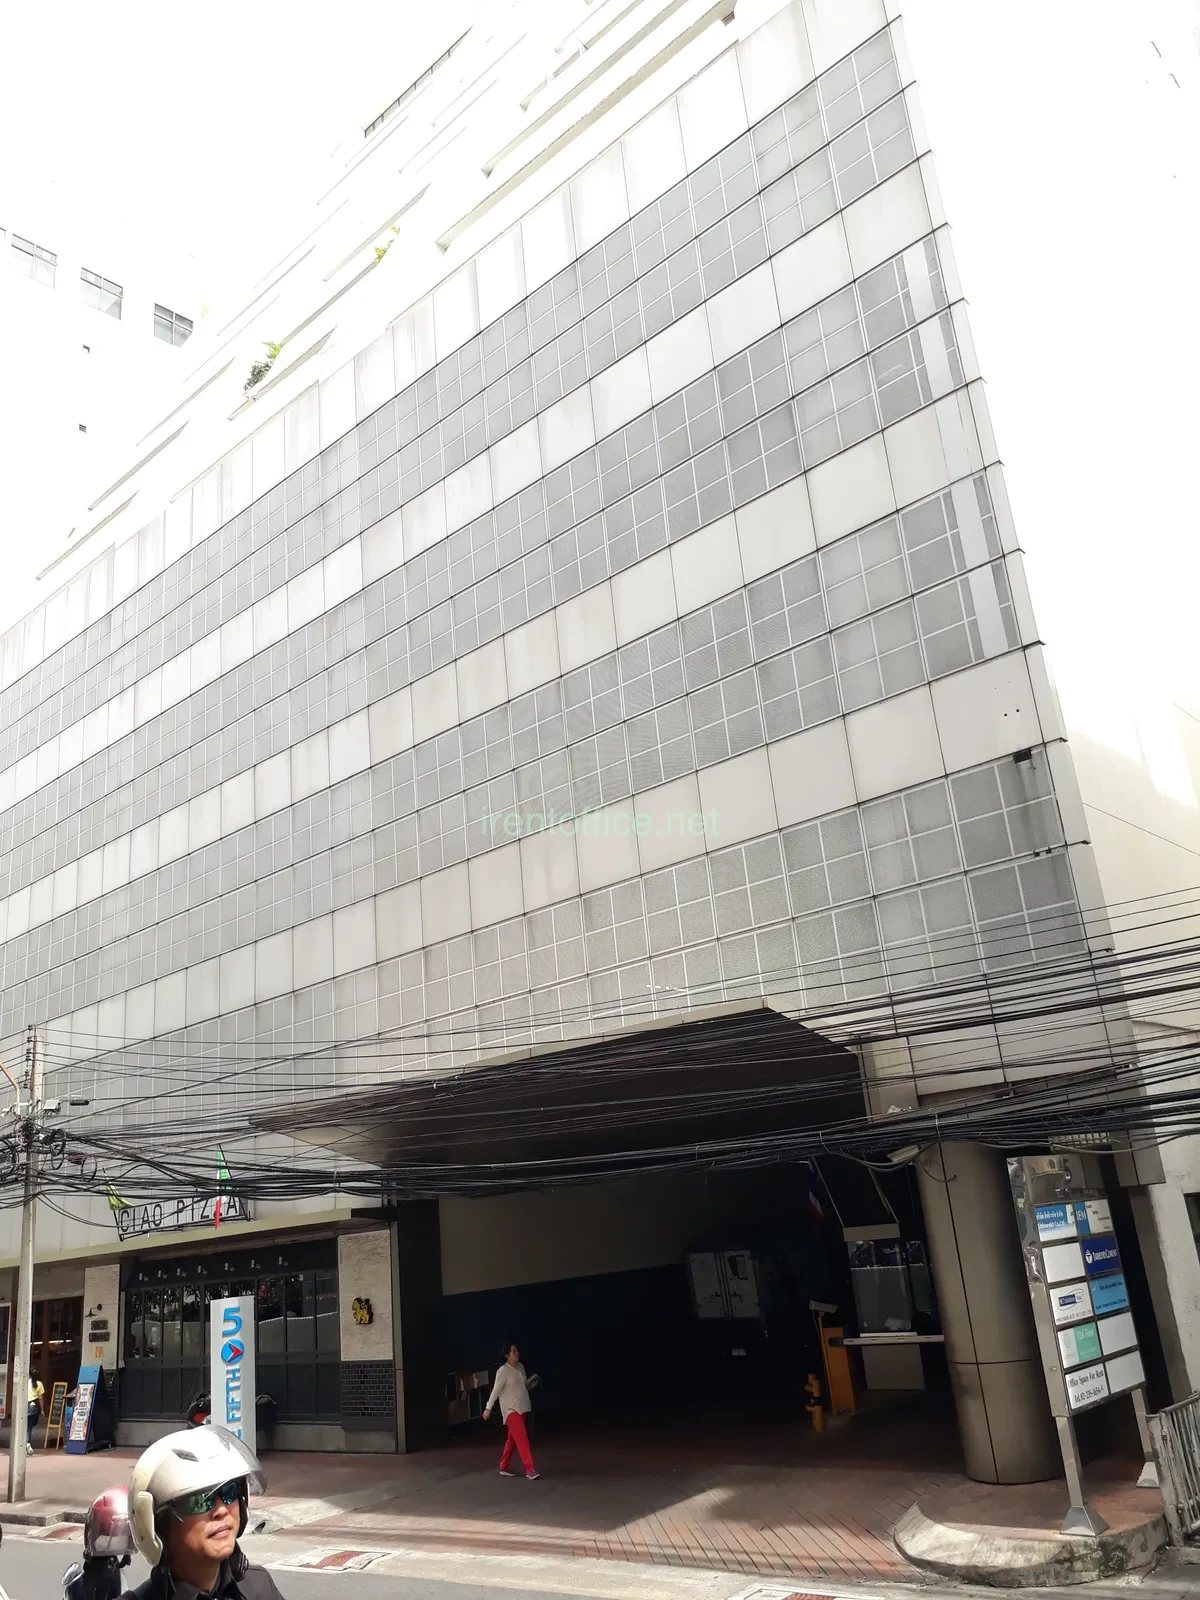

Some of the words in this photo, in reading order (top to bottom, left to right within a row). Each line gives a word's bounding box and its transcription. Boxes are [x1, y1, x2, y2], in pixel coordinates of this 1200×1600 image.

[120, 1203, 162, 1232] CIAO
[222, 1306, 243, 1337] 5
[225, 1367, 242, 1424] FIFTH
